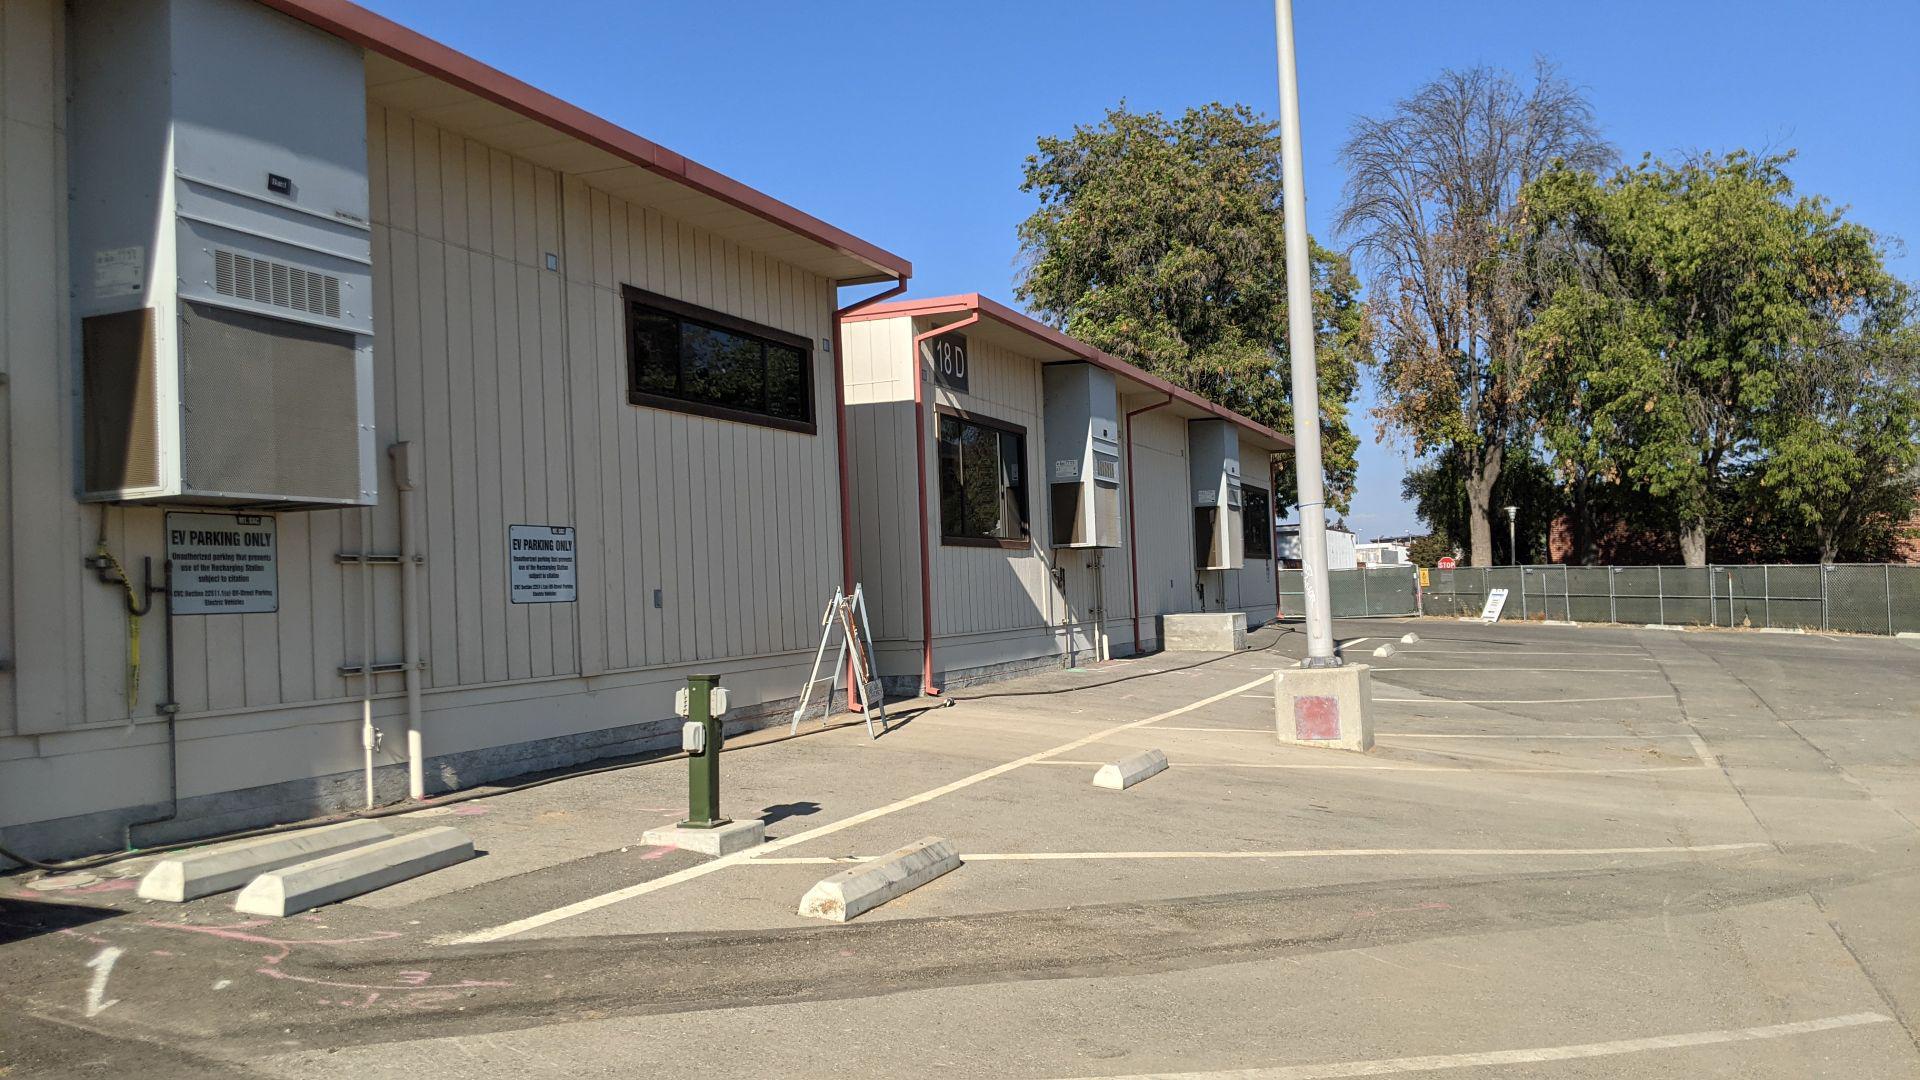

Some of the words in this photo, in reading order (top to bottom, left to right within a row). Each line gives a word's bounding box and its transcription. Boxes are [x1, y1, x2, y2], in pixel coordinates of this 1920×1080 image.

[171, 530, 186, 545] EV
[189, 531, 241, 546] PARKING
[244, 532, 272, 547] ONLY
[512, 539, 522, 550] EV
[523, 539, 554, 551] PARKING
[555, 540, 573, 551] ONLY
[213, 553, 235, 562] parking
[193, 564, 199, 572] of
[200, 564, 210, 572] the
[1438, 561, 1456, 569] STOP
